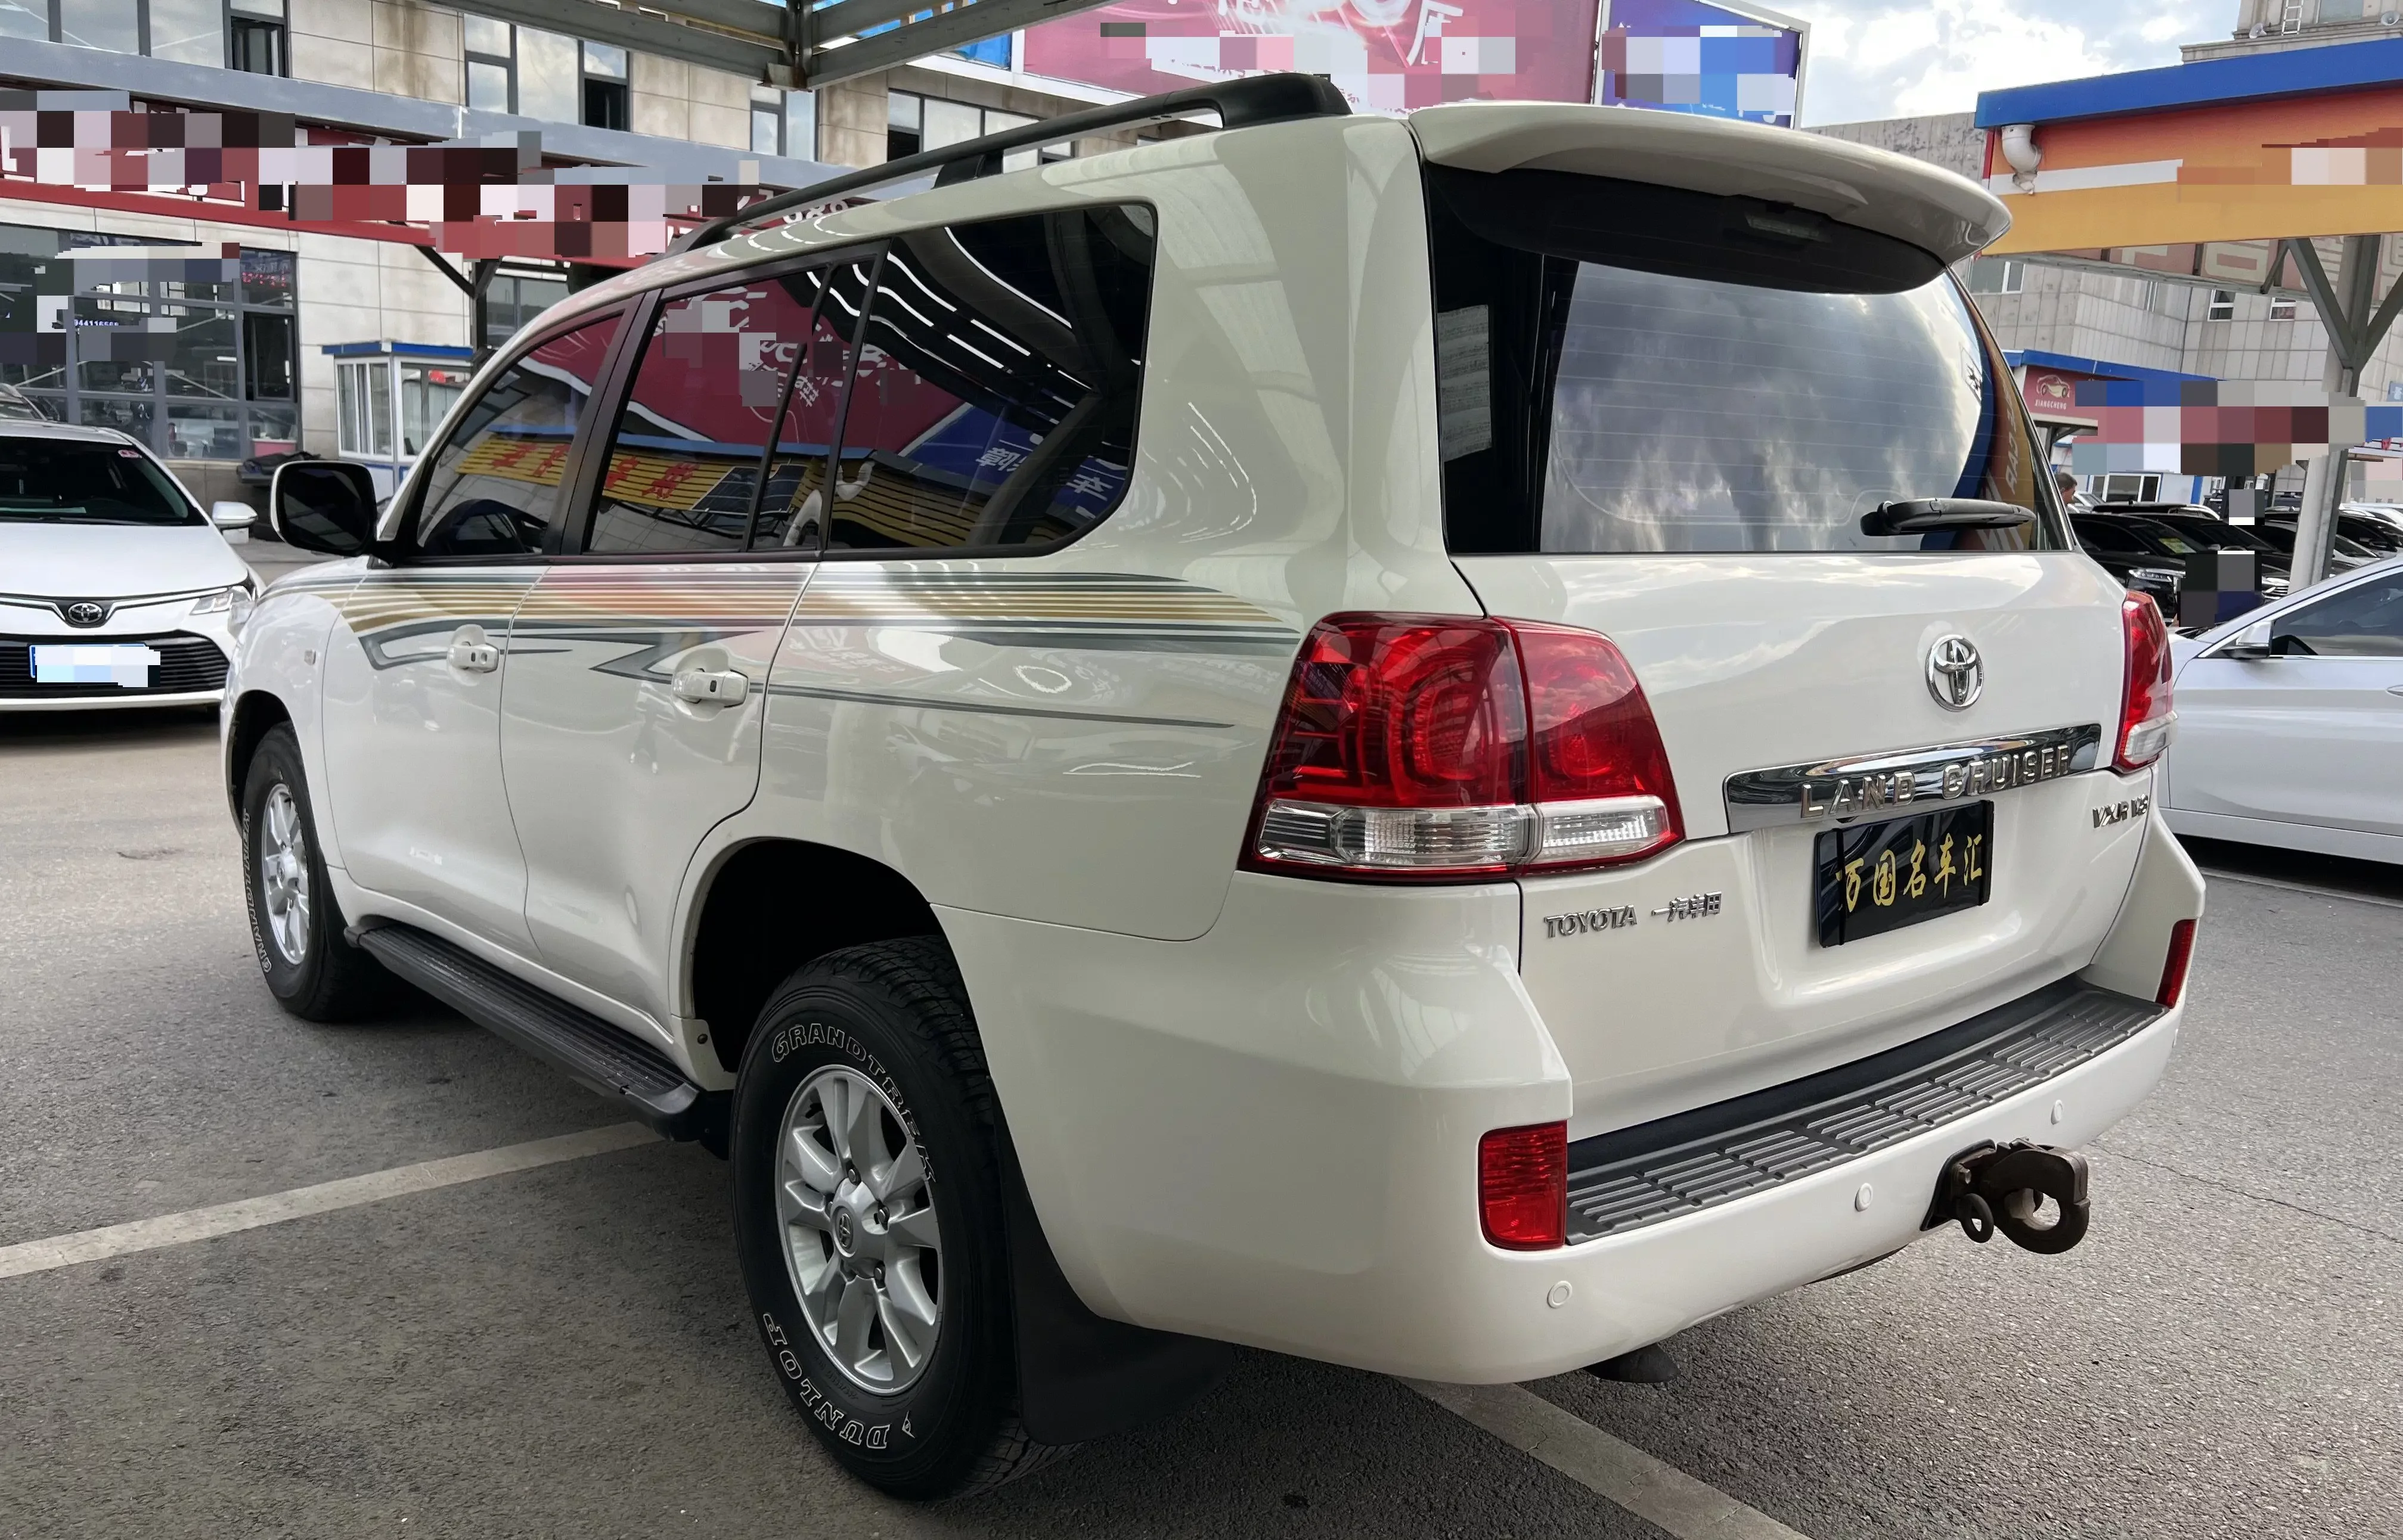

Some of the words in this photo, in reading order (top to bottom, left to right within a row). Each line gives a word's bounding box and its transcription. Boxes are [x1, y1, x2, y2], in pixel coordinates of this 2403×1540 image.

[2035, 399, 2067, 410] XIANGCHENG
[1800, 771, 1916, 819] LAND
[1942, 744, 2070, 800] CRUISER
[2092, 803, 2129, 829] VXR
[2131, 793, 2148, 818] V8
[1543, 904, 1638, 938] TOYOTA
[1651, 891, 1722, 923] 一汽丰田
[762, 1313, 891, 1449] DUNLOP
